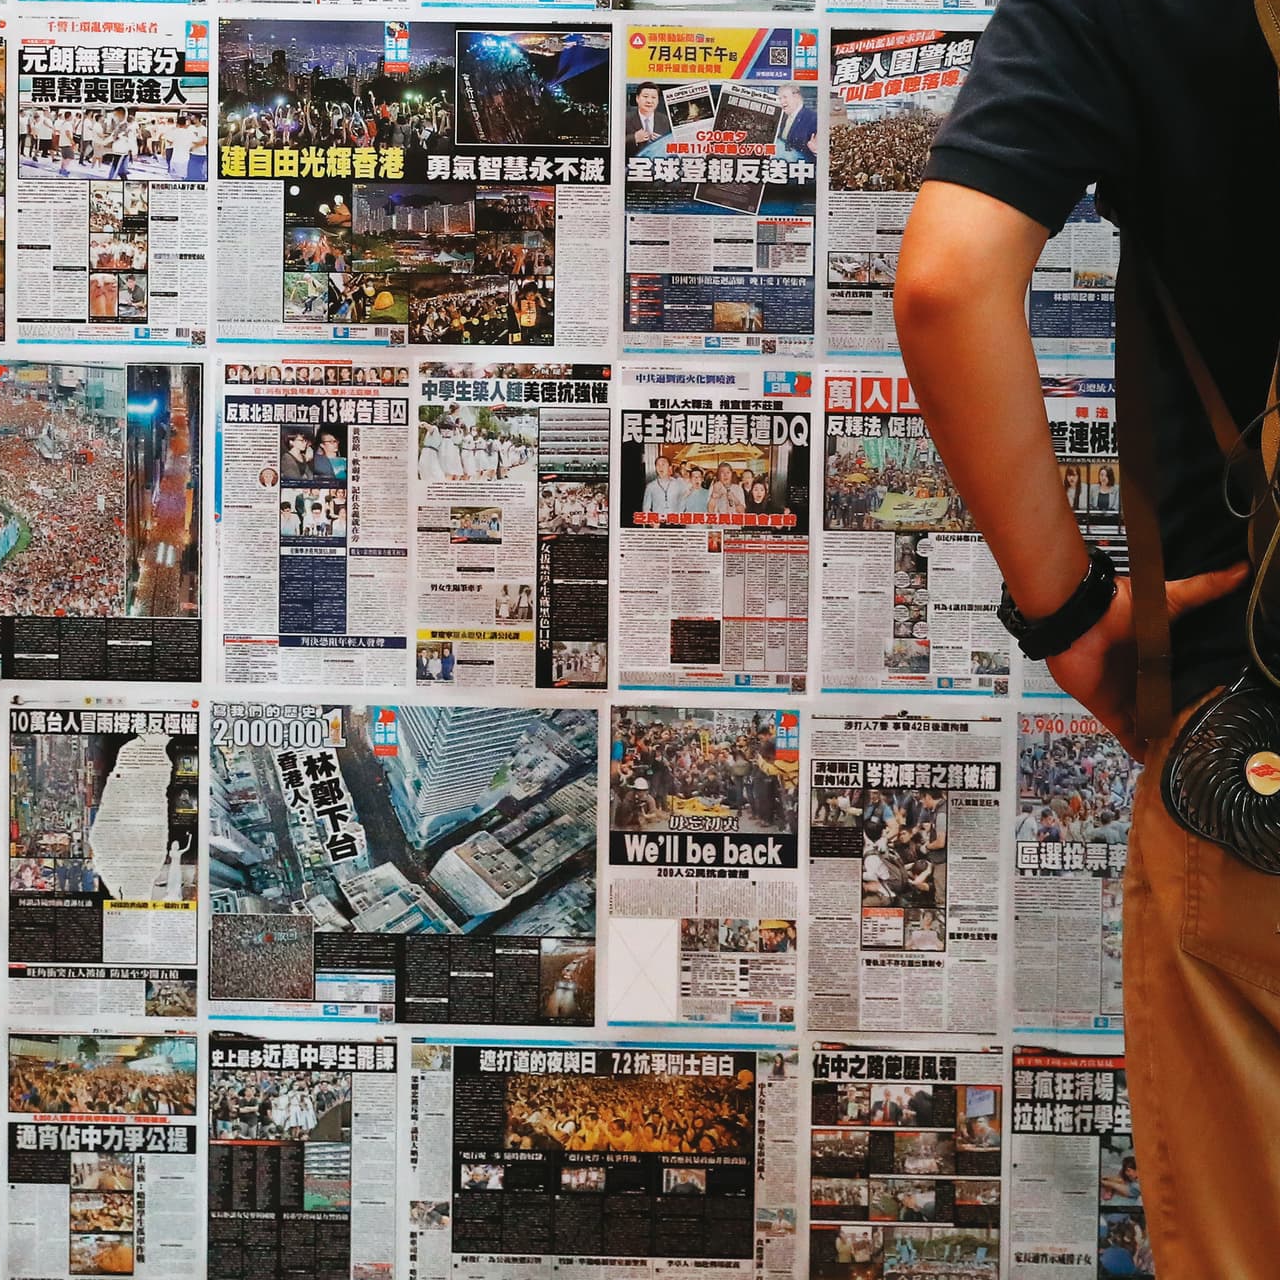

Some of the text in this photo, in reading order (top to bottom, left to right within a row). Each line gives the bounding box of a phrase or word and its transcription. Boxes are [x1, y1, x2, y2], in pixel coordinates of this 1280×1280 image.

[23, 46, 178, 75] 元朗無警時分
[31, 76, 188, 105] 黑幫喪毆途人
[221, 146, 405, 180] 建自由光輝香港
[427, 154, 606, 183] 勇氣智慧永不滅
[627, 156, 816, 186] 全球登報反送中
[623, 412, 809, 447] 民主派四議員遭DQ
[887, 415, 930, 438] 促撤
[1050, 421, 1119, 455] 誓連根
[304, 751, 359, 864] 林鄭下台
[624, 833, 783, 865] We'll be back
